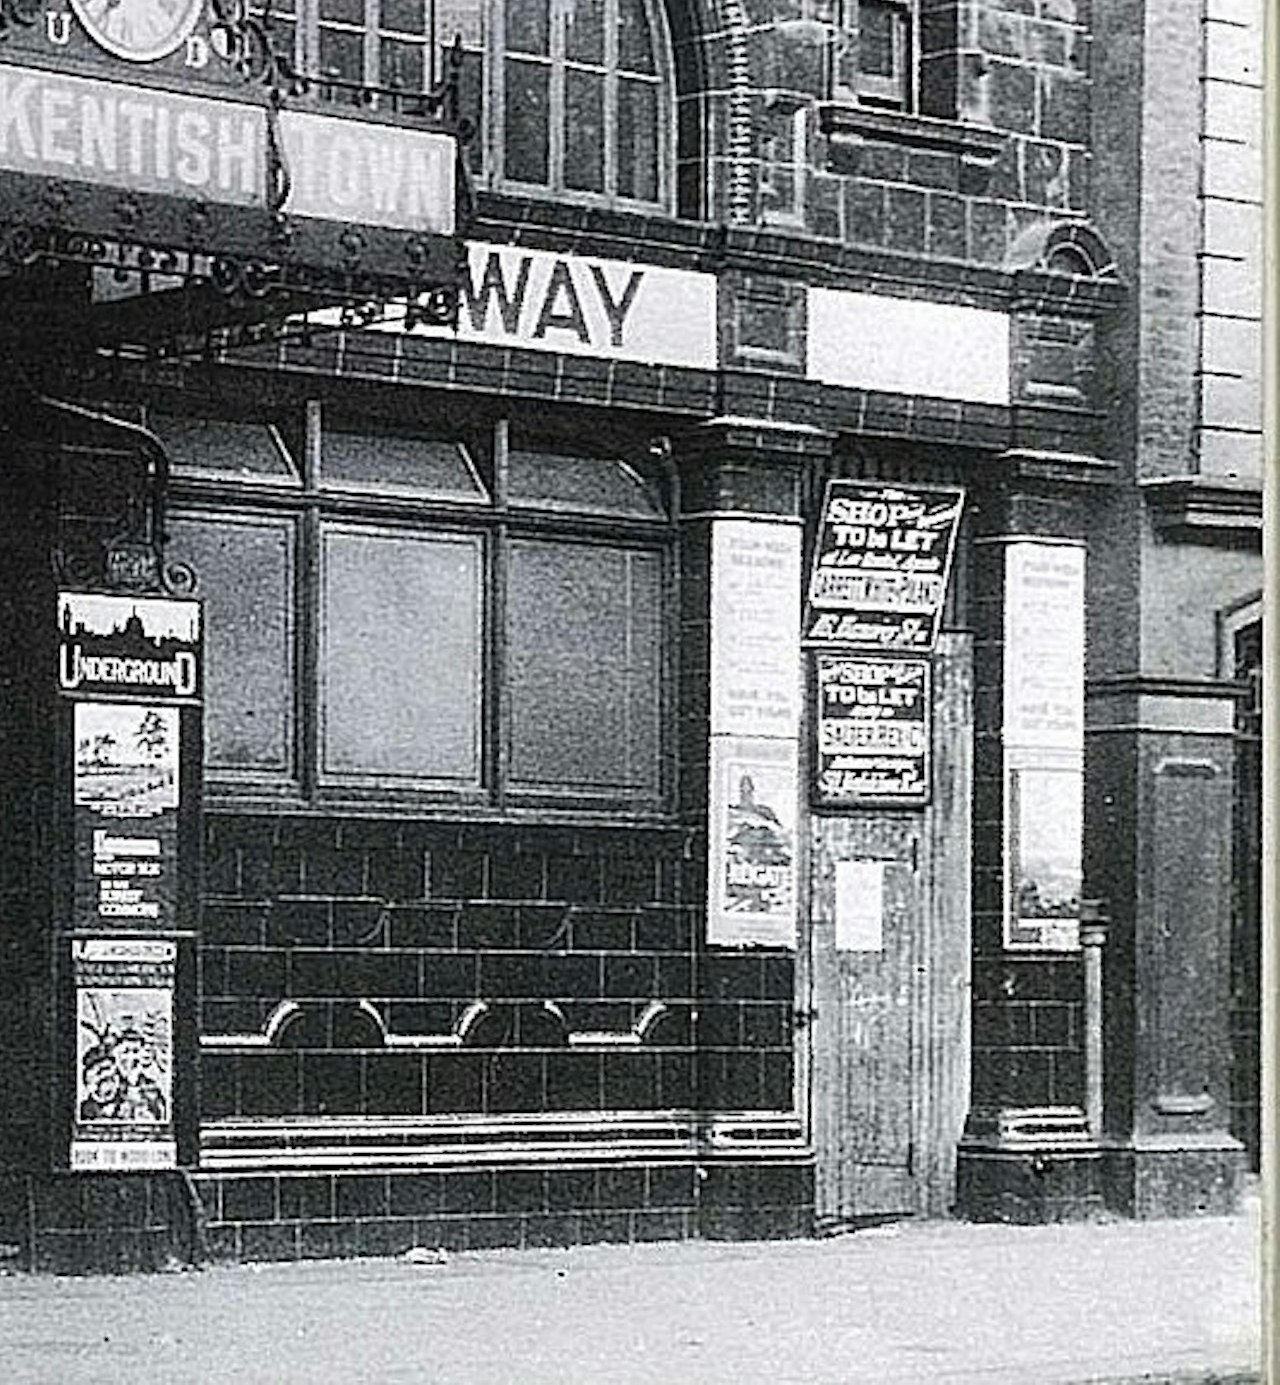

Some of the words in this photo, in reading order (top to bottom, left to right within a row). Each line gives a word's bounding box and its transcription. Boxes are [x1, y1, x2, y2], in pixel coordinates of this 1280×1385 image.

[46, 11, 71, 45] U
[185, 36, 208, 67] D
[296, 121, 445, 215] TOWN
[462, 249, 645, 348] WAY
[890, 529, 939, 551] LET
[879, 687, 919, 706] LET
